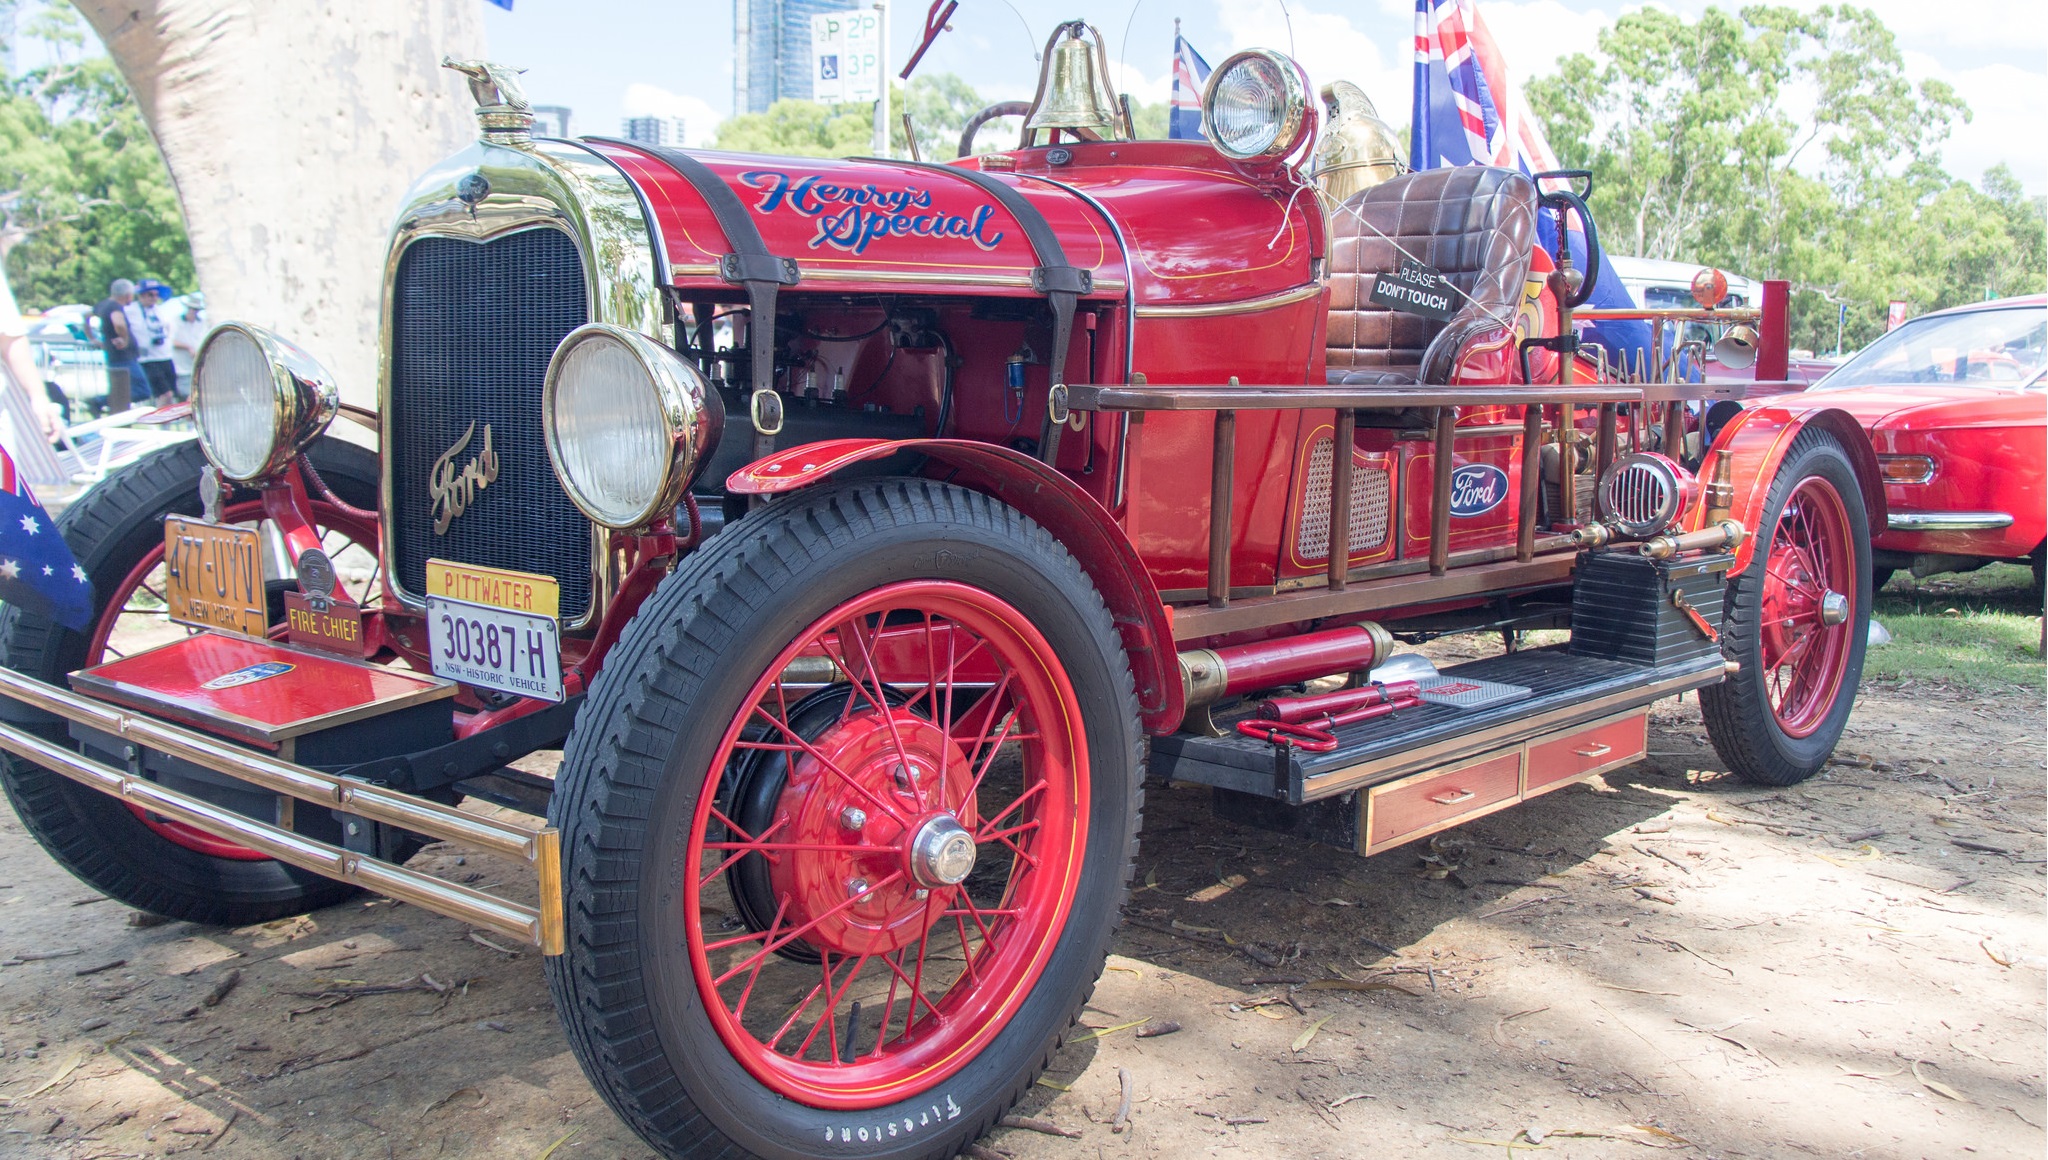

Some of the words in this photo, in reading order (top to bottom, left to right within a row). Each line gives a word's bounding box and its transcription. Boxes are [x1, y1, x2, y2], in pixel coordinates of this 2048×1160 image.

[847, 16, 876, 38] 2P
[848, 54, 876, 75] 3P
[737, 171, 932, 217] Henry's
[808, 204, 1004, 256] Special
[1400, 267, 1437, 288] PLEASE
[1377, 281, 1407, 300] DON'T
[1407, 289, 1448, 311] TOUCH
[429, 420, 499, 535] Ford
[1450, 471, 1496, 508] Ford
[445, 570, 532, 610] PITTWATER
[189, 598, 209, 620] NEW
[212, 602, 238, 625] YORK
[289, 608, 319, 635] FIRE
[322, 615, 358, 642] CHIEF
[509, 676, 548, 693] VEHICLE
[825, 1094, 961, 1142] Firestone
